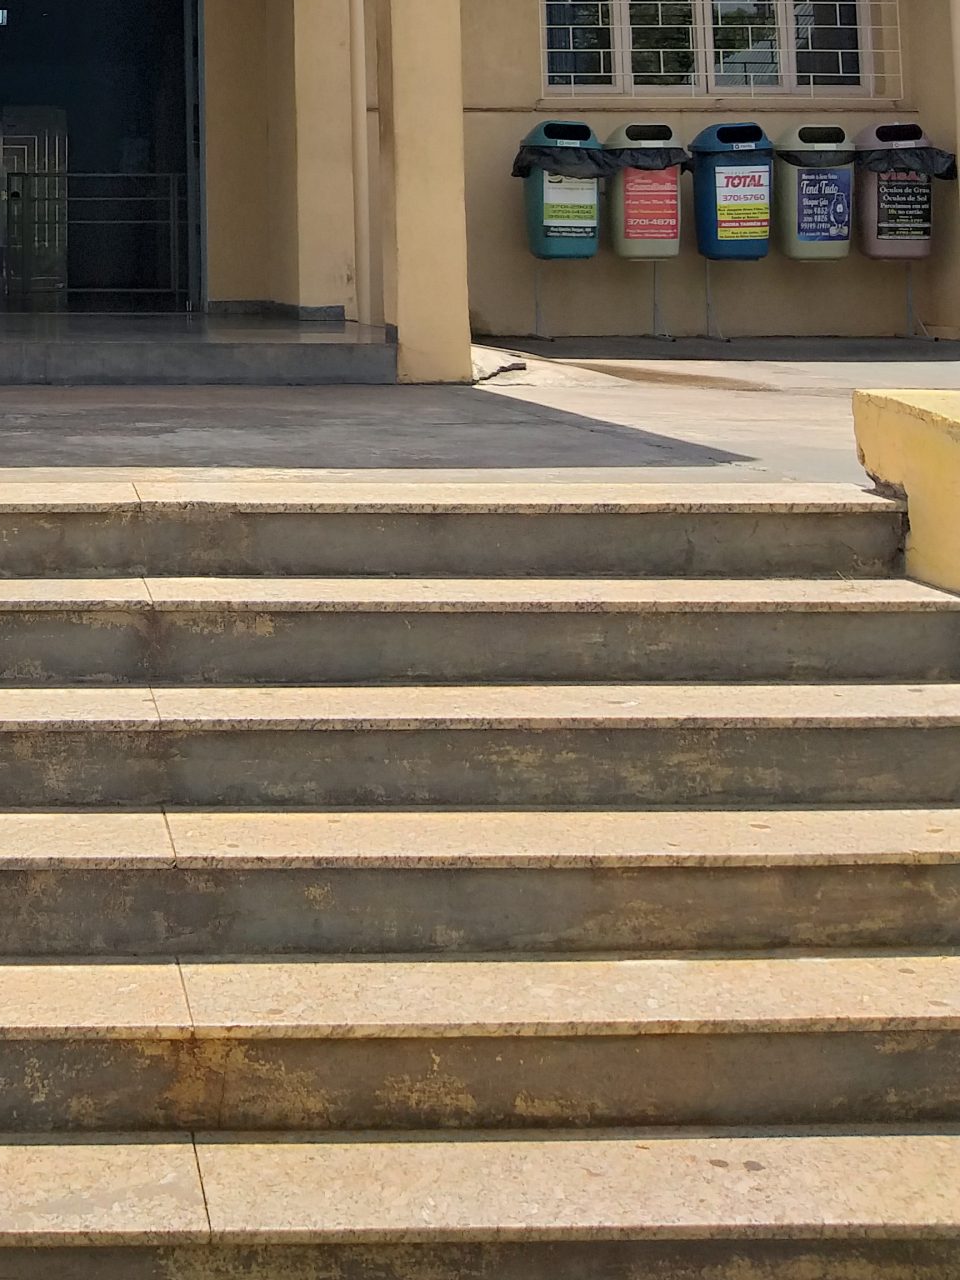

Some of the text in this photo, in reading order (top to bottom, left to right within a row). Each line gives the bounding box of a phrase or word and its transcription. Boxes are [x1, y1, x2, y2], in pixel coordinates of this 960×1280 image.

[724, 175, 764, 188] TOTAL
[880, 185, 903, 193] Óculos
[722, 194, 766, 202] 3701-5760
